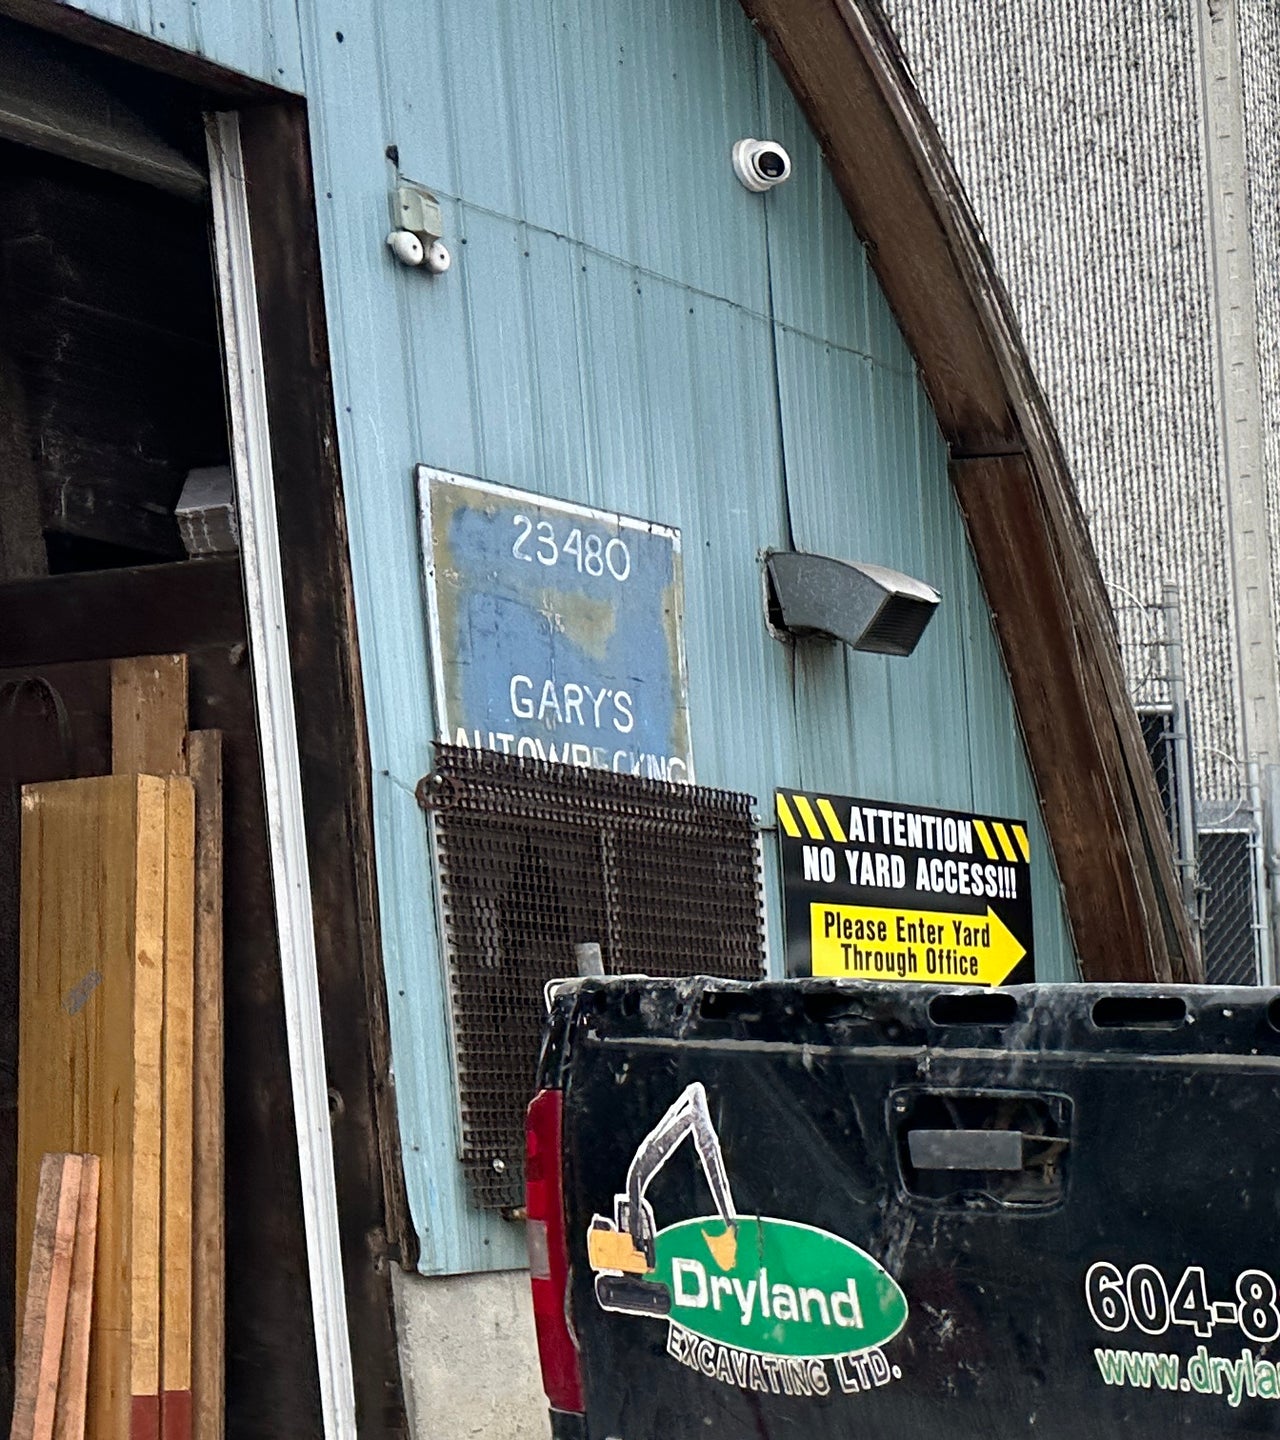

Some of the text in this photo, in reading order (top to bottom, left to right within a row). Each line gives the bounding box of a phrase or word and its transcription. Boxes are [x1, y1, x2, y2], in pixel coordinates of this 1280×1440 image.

[512, 514, 631, 581] 23480
[509, 674, 634, 733] GARY'S
[849, 805, 974, 854] ATTENTION
[802, 845, 1017, 899] NO YARD ACCESS!!!
[823, 910, 991, 948] Please Enter Yard
[840, 943, 979, 977] Through Office
[671, 1256, 864, 1329] Dryland
[667, 1321, 902, 1396] EXCAVATING LTD.
